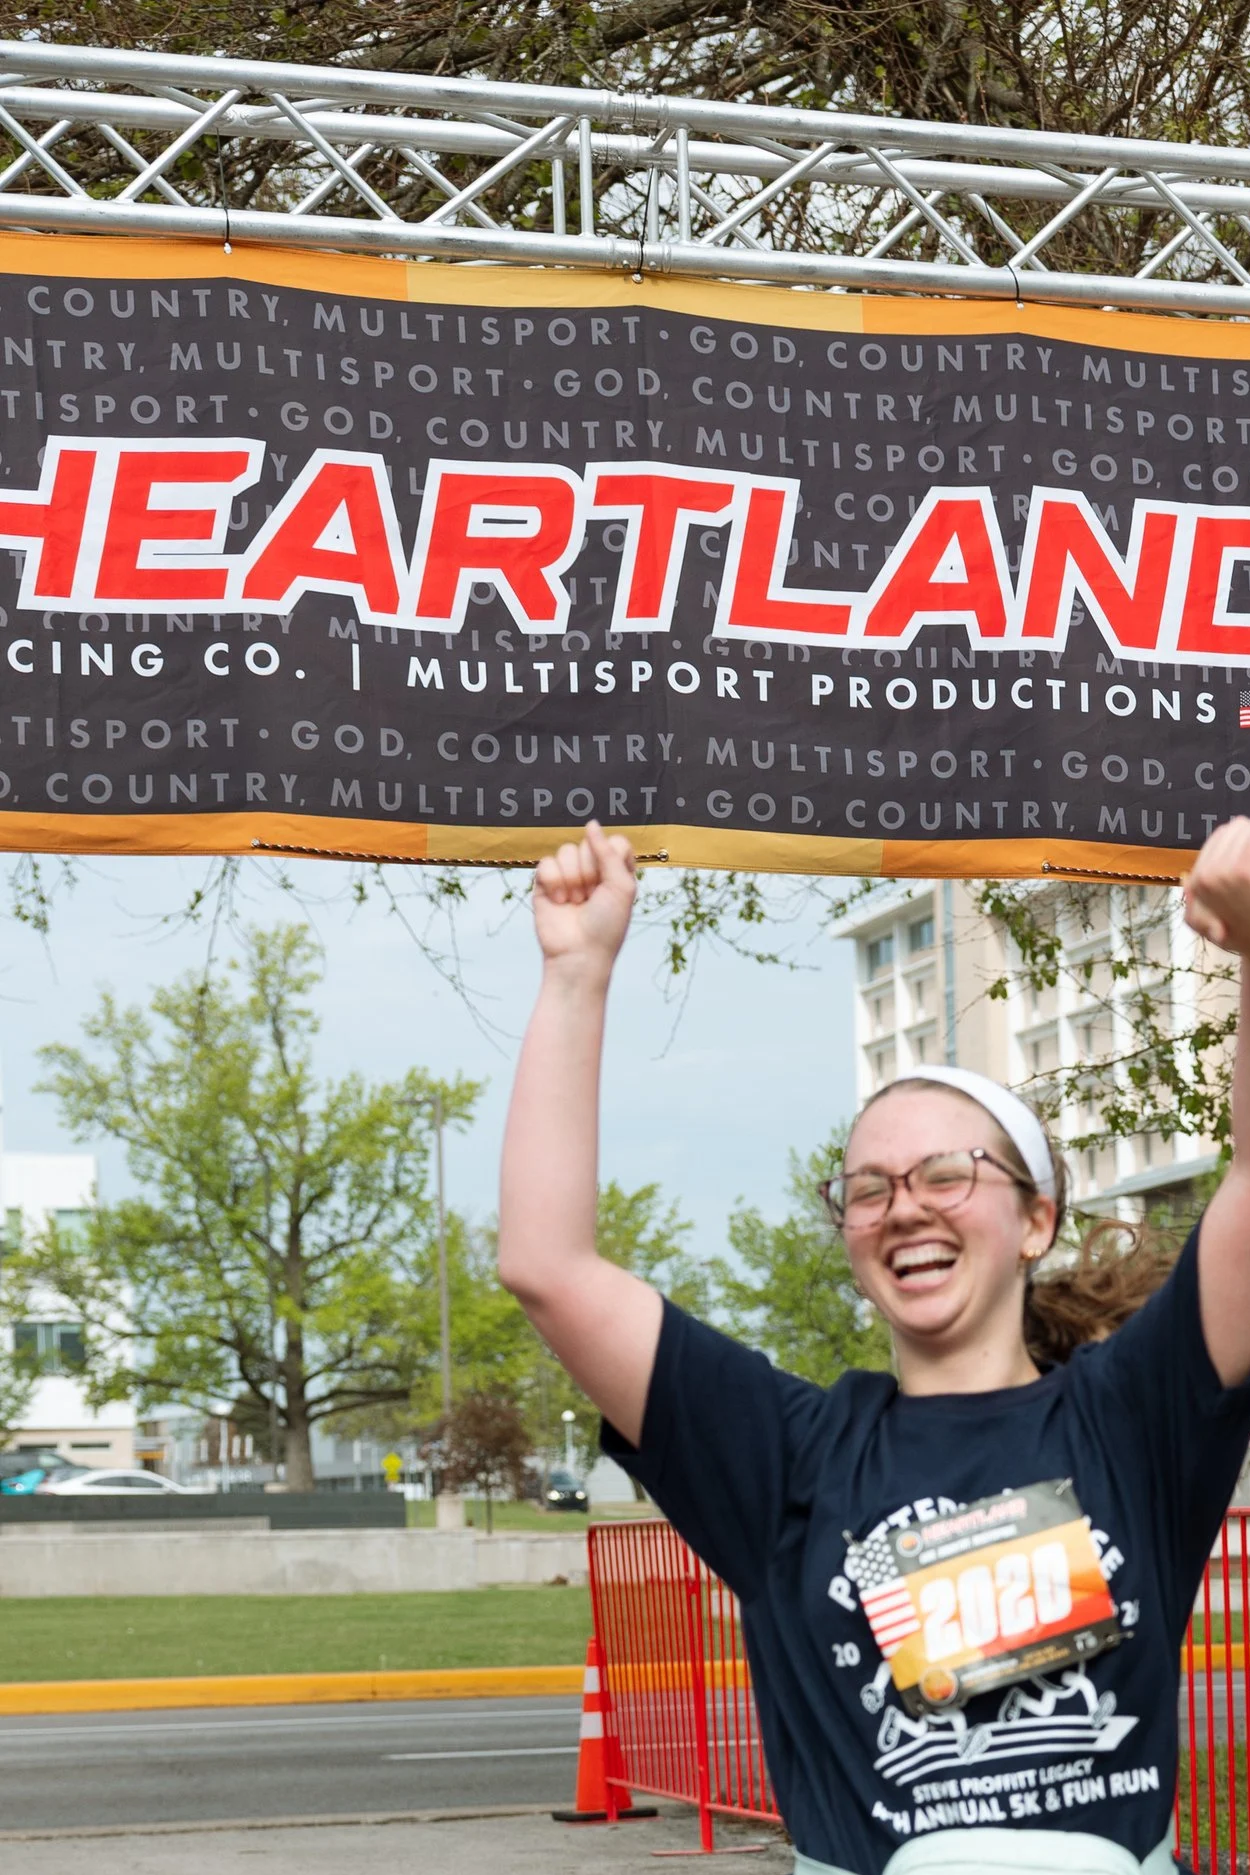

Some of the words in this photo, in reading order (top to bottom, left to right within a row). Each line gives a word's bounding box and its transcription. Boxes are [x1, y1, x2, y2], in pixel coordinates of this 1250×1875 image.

[27, 286, 289, 327] COUNTRY,
[313, 302, 640, 346] MULTISPORT
[689, 325, 804, 368] GOD,
[826, 341, 1061, 378] COUNTRY,
[169, 342, 504, 396] MULTISPORT
[554, 367, 669, 401] GOD,
[692, 376, 932, 425] COUNTRY,
[280, 401, 402, 443] GOD,
[426, 416, 671, 452] COUNTRY,
[695, 426, 1005, 473] MULTISPORT
[1052, 448, 1161, 489] GOD,
[204, 642, 305, 679] CO.
[406, 656, 774, 702] MULTISPORT
[811, 673, 1217, 724] PRODUCTIONS
[291, 720, 413, 761] GOD,
[437, 731, 682, 765] COUNTRY,
[705, 736, 1016, 779] MULTISPORT
[1061, 750, 1172, 789] GOD,
[46, 772, 305, 806] COUNTRY,
[330, 777, 657, 818] MULTISPORT
[706, 789, 822, 828] GOD,
[845, 799, 1075, 833] COUNTRY,
[832, 1642, 861, 1668] 20
[1010, 1790, 1042, 1819] 5K
[1045, 1788, 1062, 1812] &
[1062, 1776, 1106, 1807] FUN
[1109, 1766, 1160, 1798] RUN
